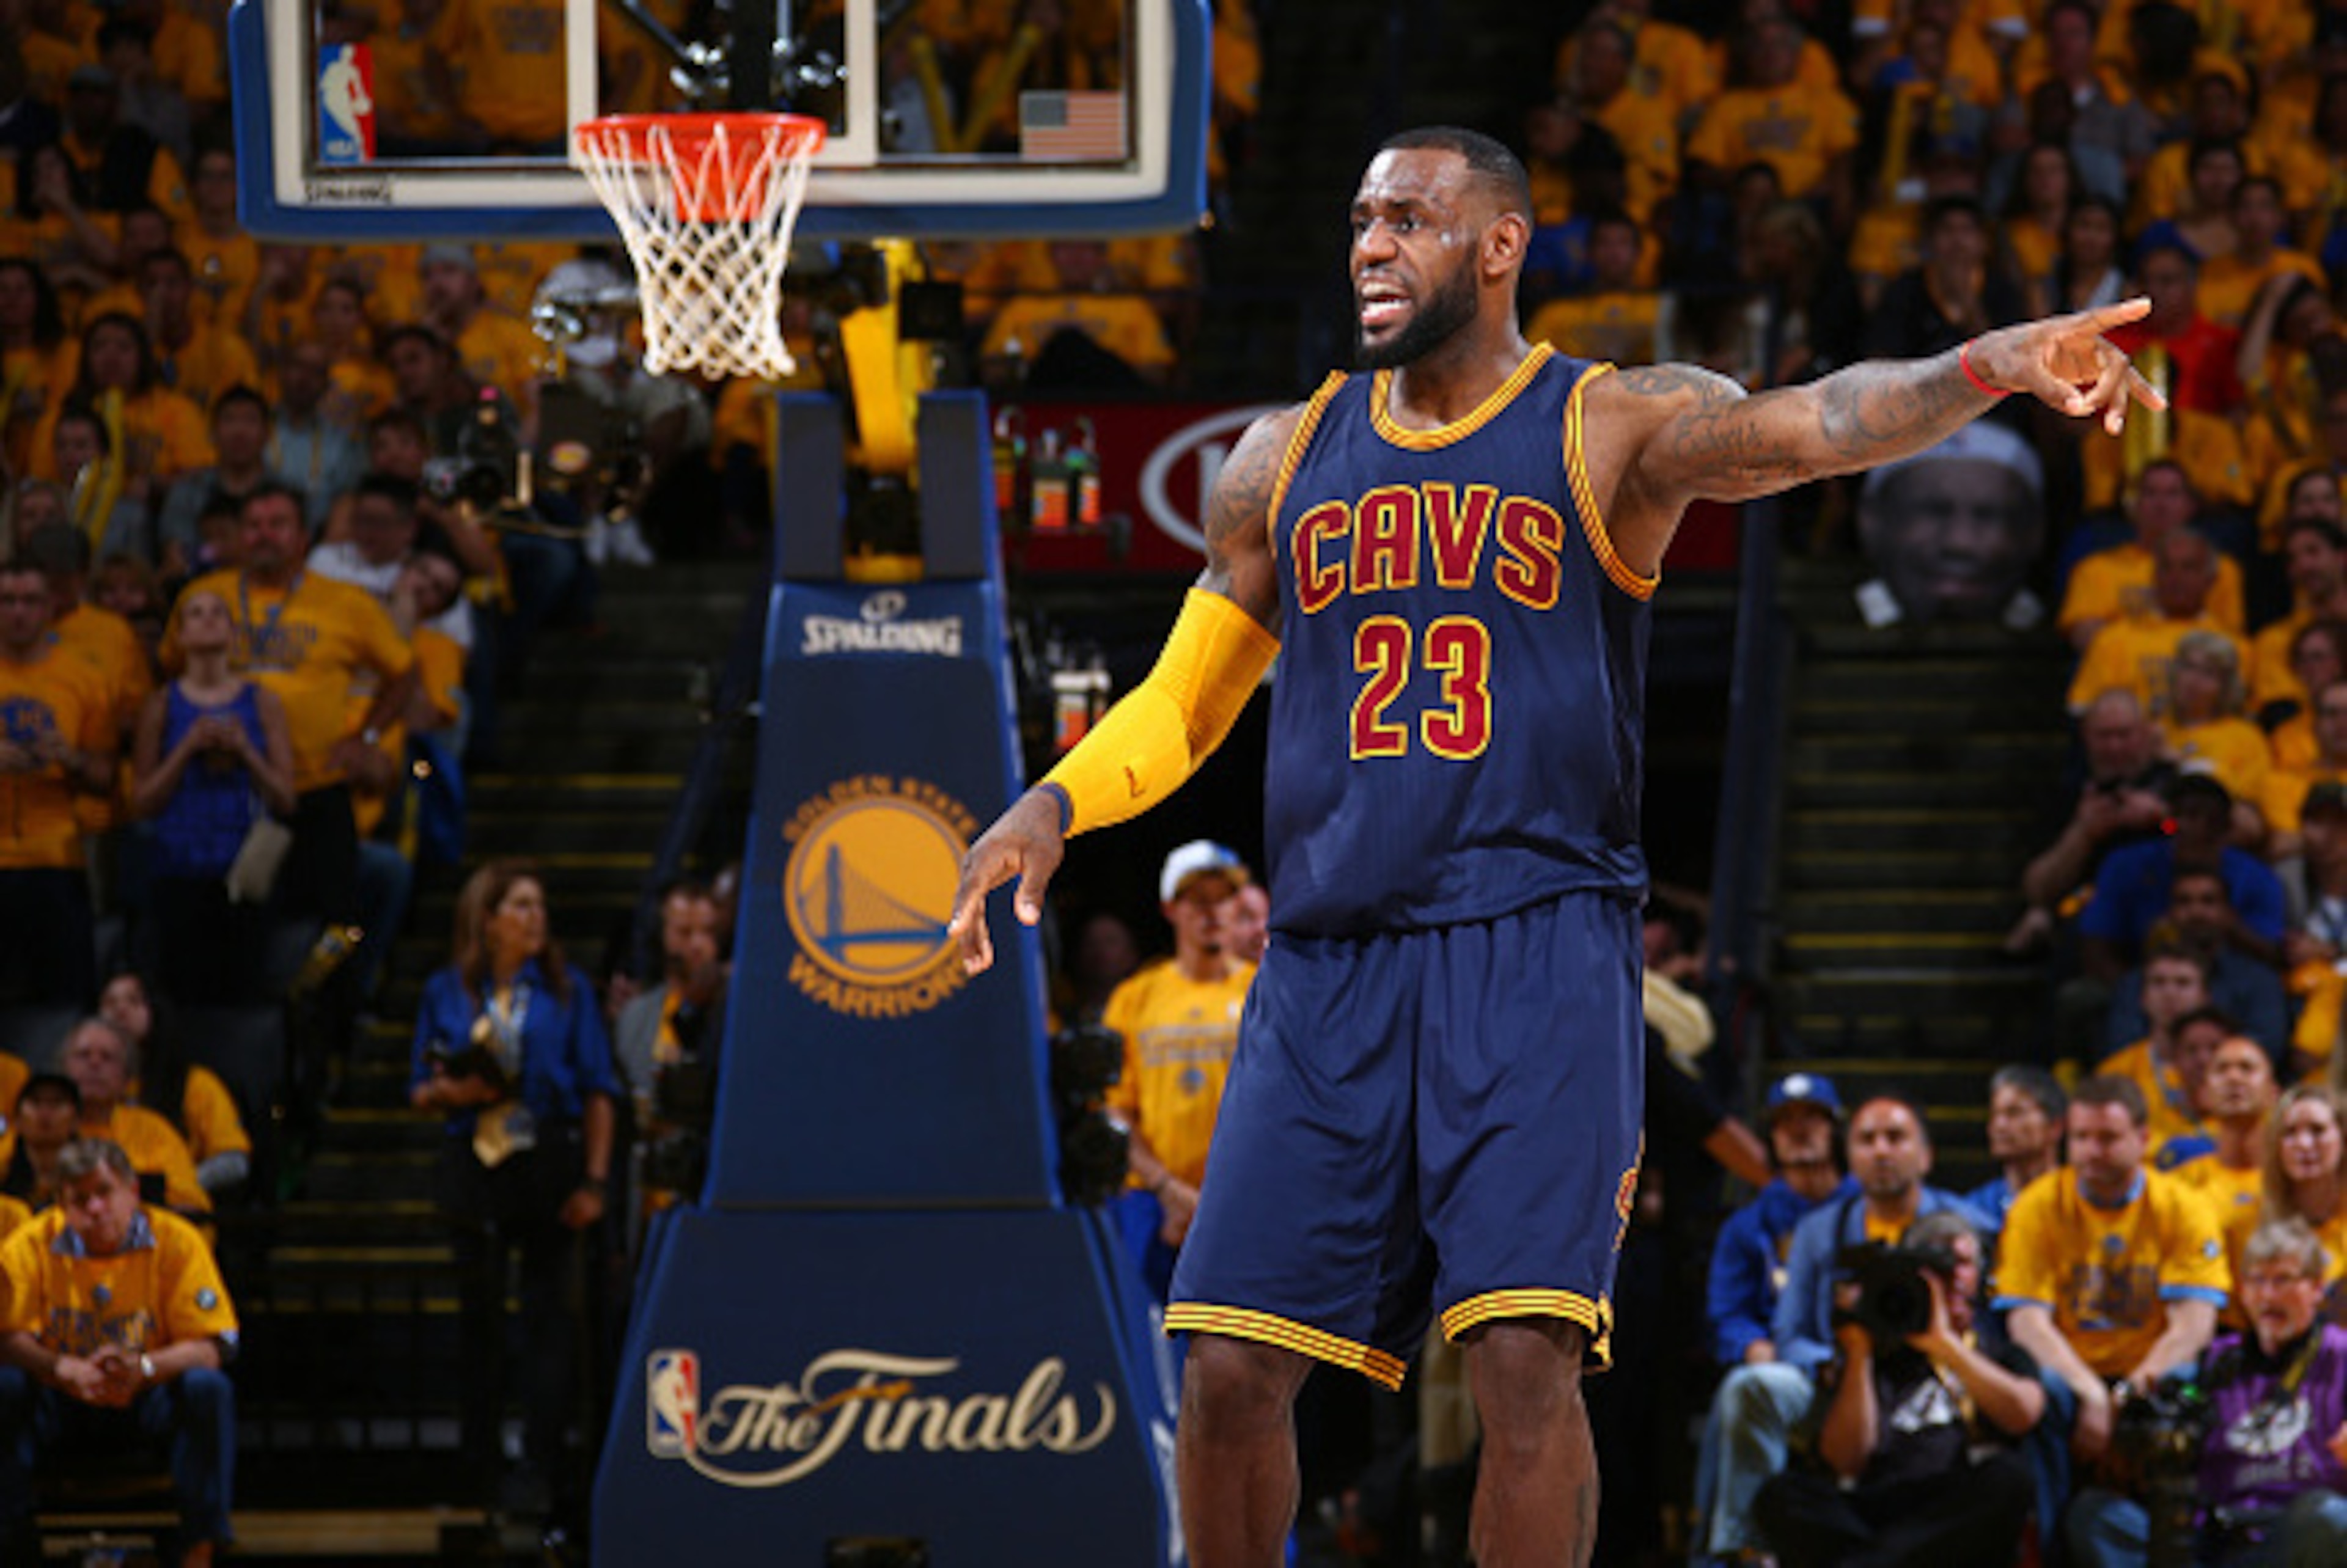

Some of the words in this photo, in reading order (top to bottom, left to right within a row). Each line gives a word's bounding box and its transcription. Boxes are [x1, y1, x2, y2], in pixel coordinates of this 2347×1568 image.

[1291, 481, 1565, 614] CAVS
[800, 615, 962, 657] SPALDING
[1350, 615, 1493, 760] 23
[782, 774, 893, 843] GOLDEN
[900, 777, 978, 838] STATE
[789, 951, 967, 1018] WARRIOR
[683, 1349, 1115, 1487] Finals
[699, 1383, 822, 1455] The
